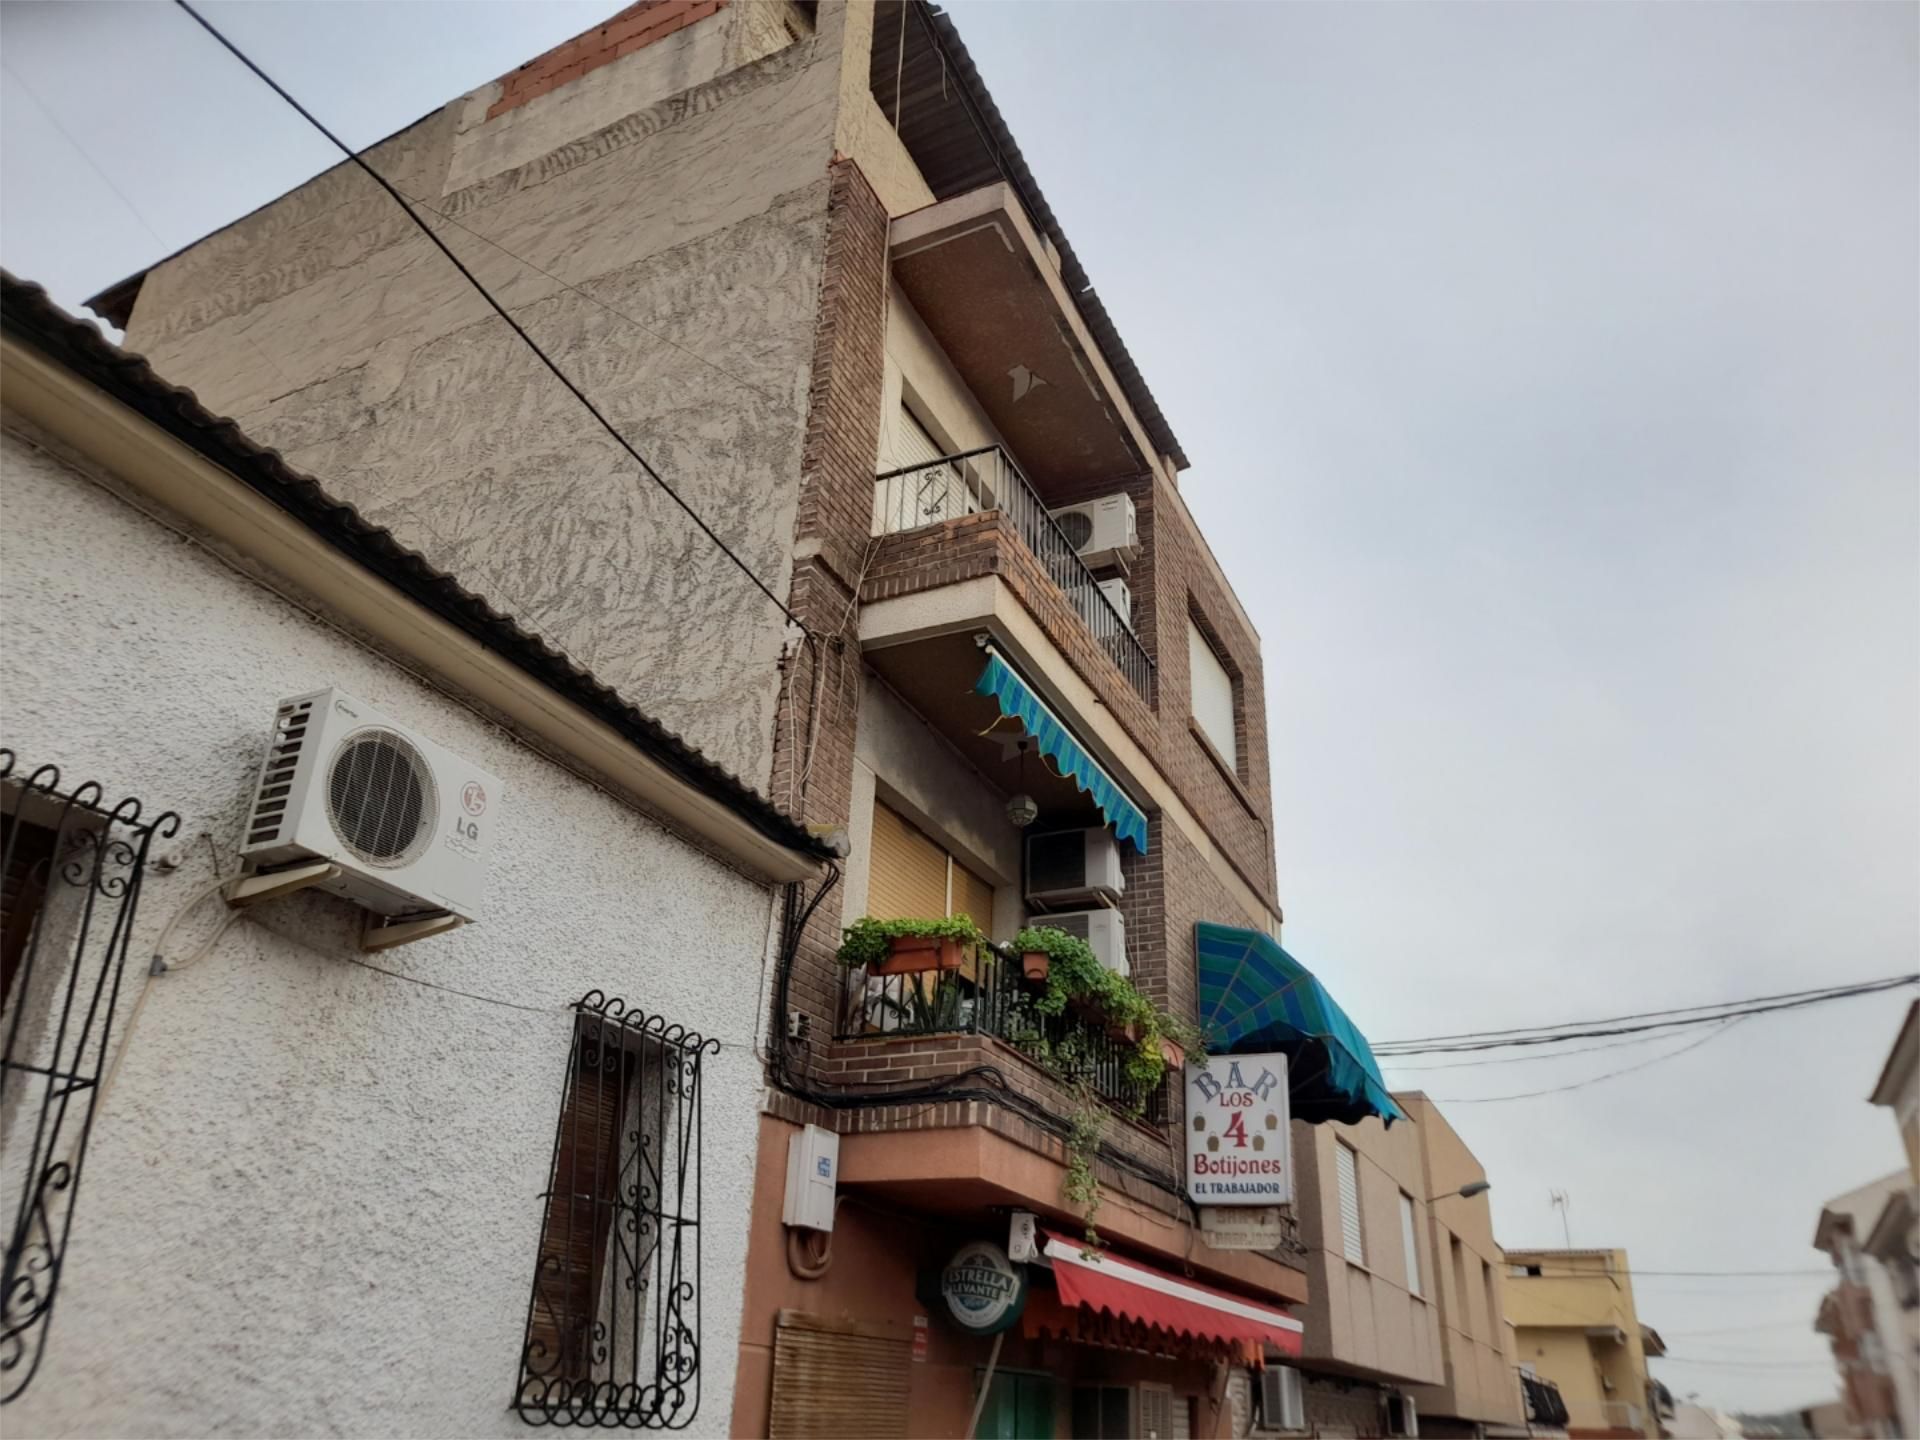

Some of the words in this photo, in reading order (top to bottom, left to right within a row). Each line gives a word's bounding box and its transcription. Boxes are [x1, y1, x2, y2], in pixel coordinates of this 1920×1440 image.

[456, 816, 479, 840] LG
[1192, 1061, 1278, 1103] BAR
[1219, 1092, 1254, 1107] LOS
[1223, 1111, 1248, 1148] 4
[1193, 1153, 1281, 1178] Botijones
[1195, 1183, 1207, 1194] EL
[949, 1268, 1009, 1290] ESTRELLA
[952, 1283, 999, 1299] LEVANTE
